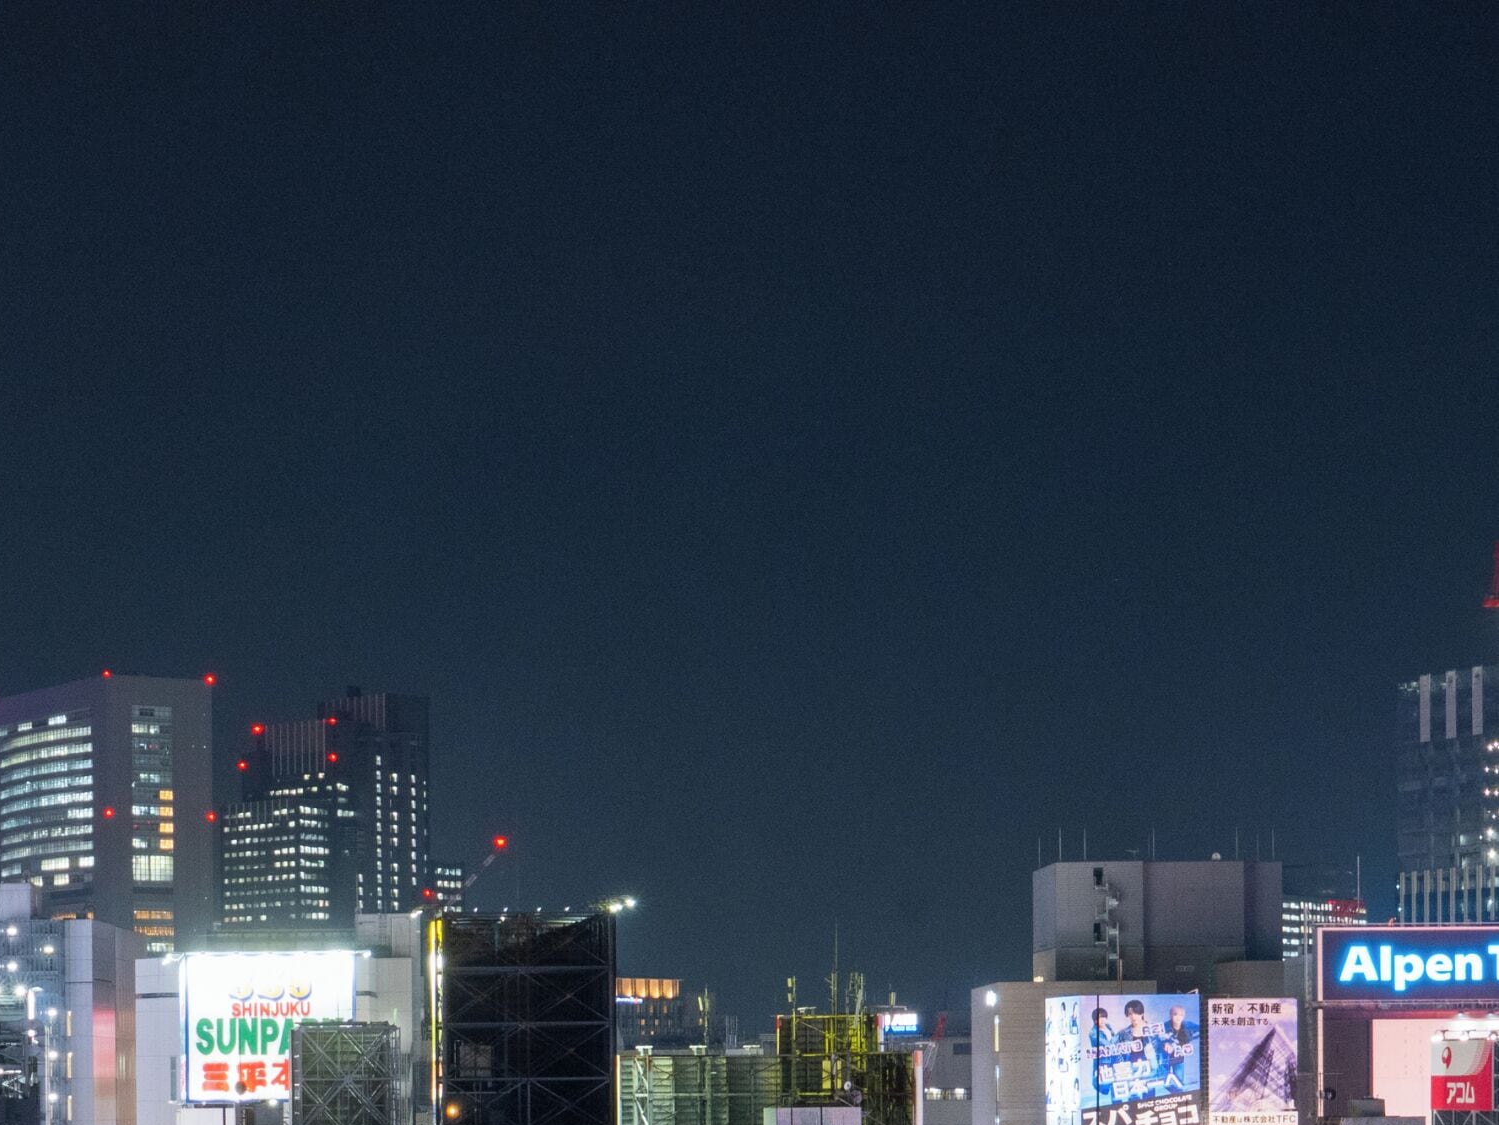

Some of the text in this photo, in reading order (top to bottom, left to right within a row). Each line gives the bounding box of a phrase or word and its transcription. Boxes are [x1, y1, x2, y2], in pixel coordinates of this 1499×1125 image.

[1339, 945, 1484, 991] Alpen
[231, 1001, 311, 1018] SHINJUKU
[1446, 1082, 1475, 1105] アコム
